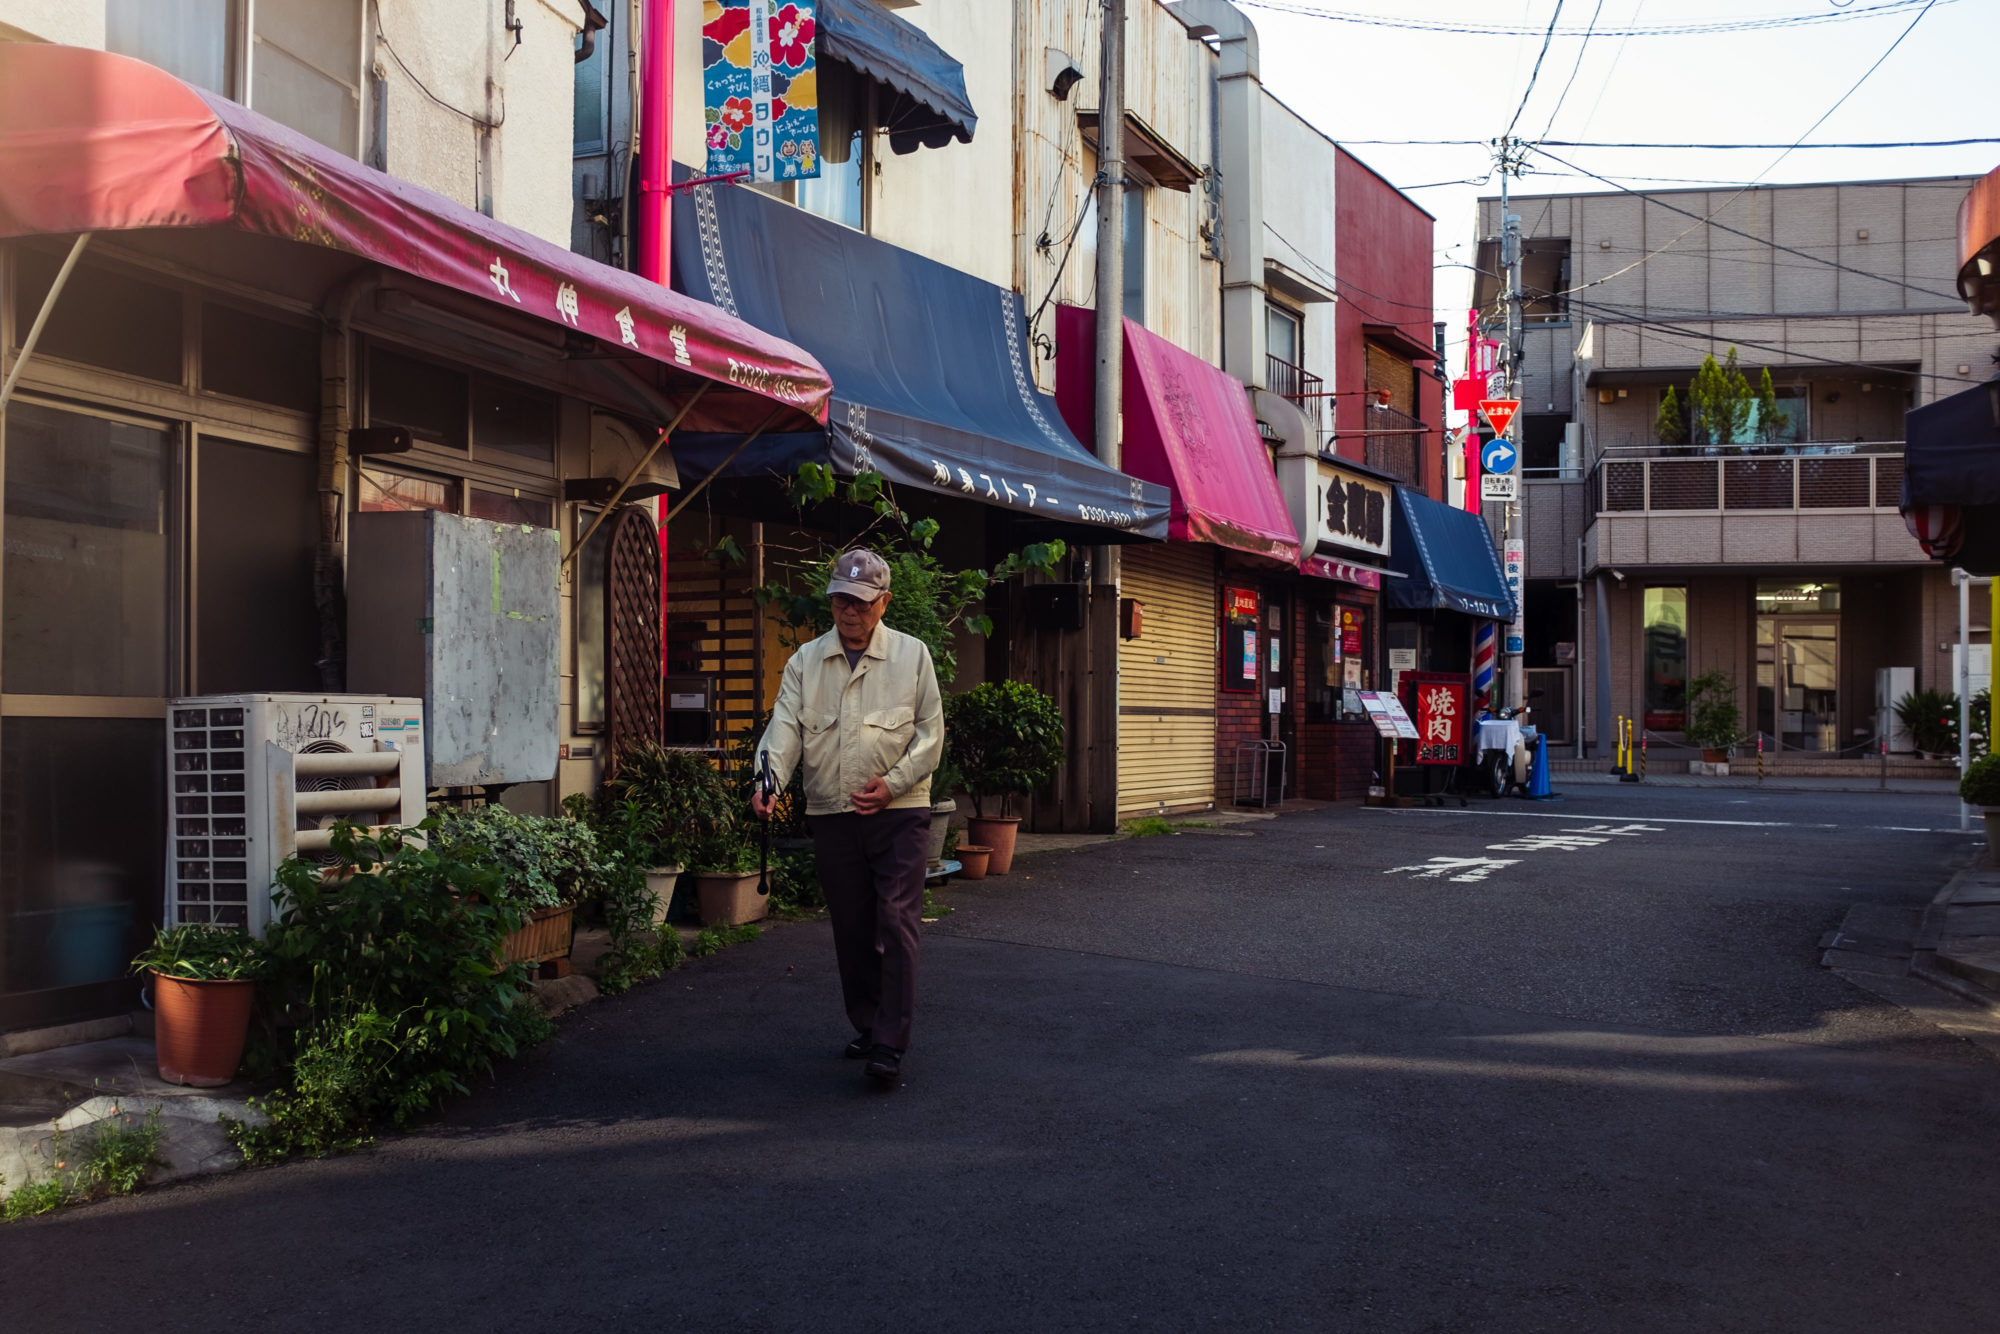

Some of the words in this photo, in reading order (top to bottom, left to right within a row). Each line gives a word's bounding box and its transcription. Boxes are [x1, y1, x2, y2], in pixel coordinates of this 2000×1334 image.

[727, 81, 750, 94] さびら
[753, 50, 770, 173] 沖縄タウン
[490, 257, 691, 366] 丸伸食堂
[1488, 407, 1512, 416] 止まれ
[1485, 484, 1513, 492] 一方通行
[850, 566, 860, 578] B
[1426, 687, 1455, 742] 焼肉
